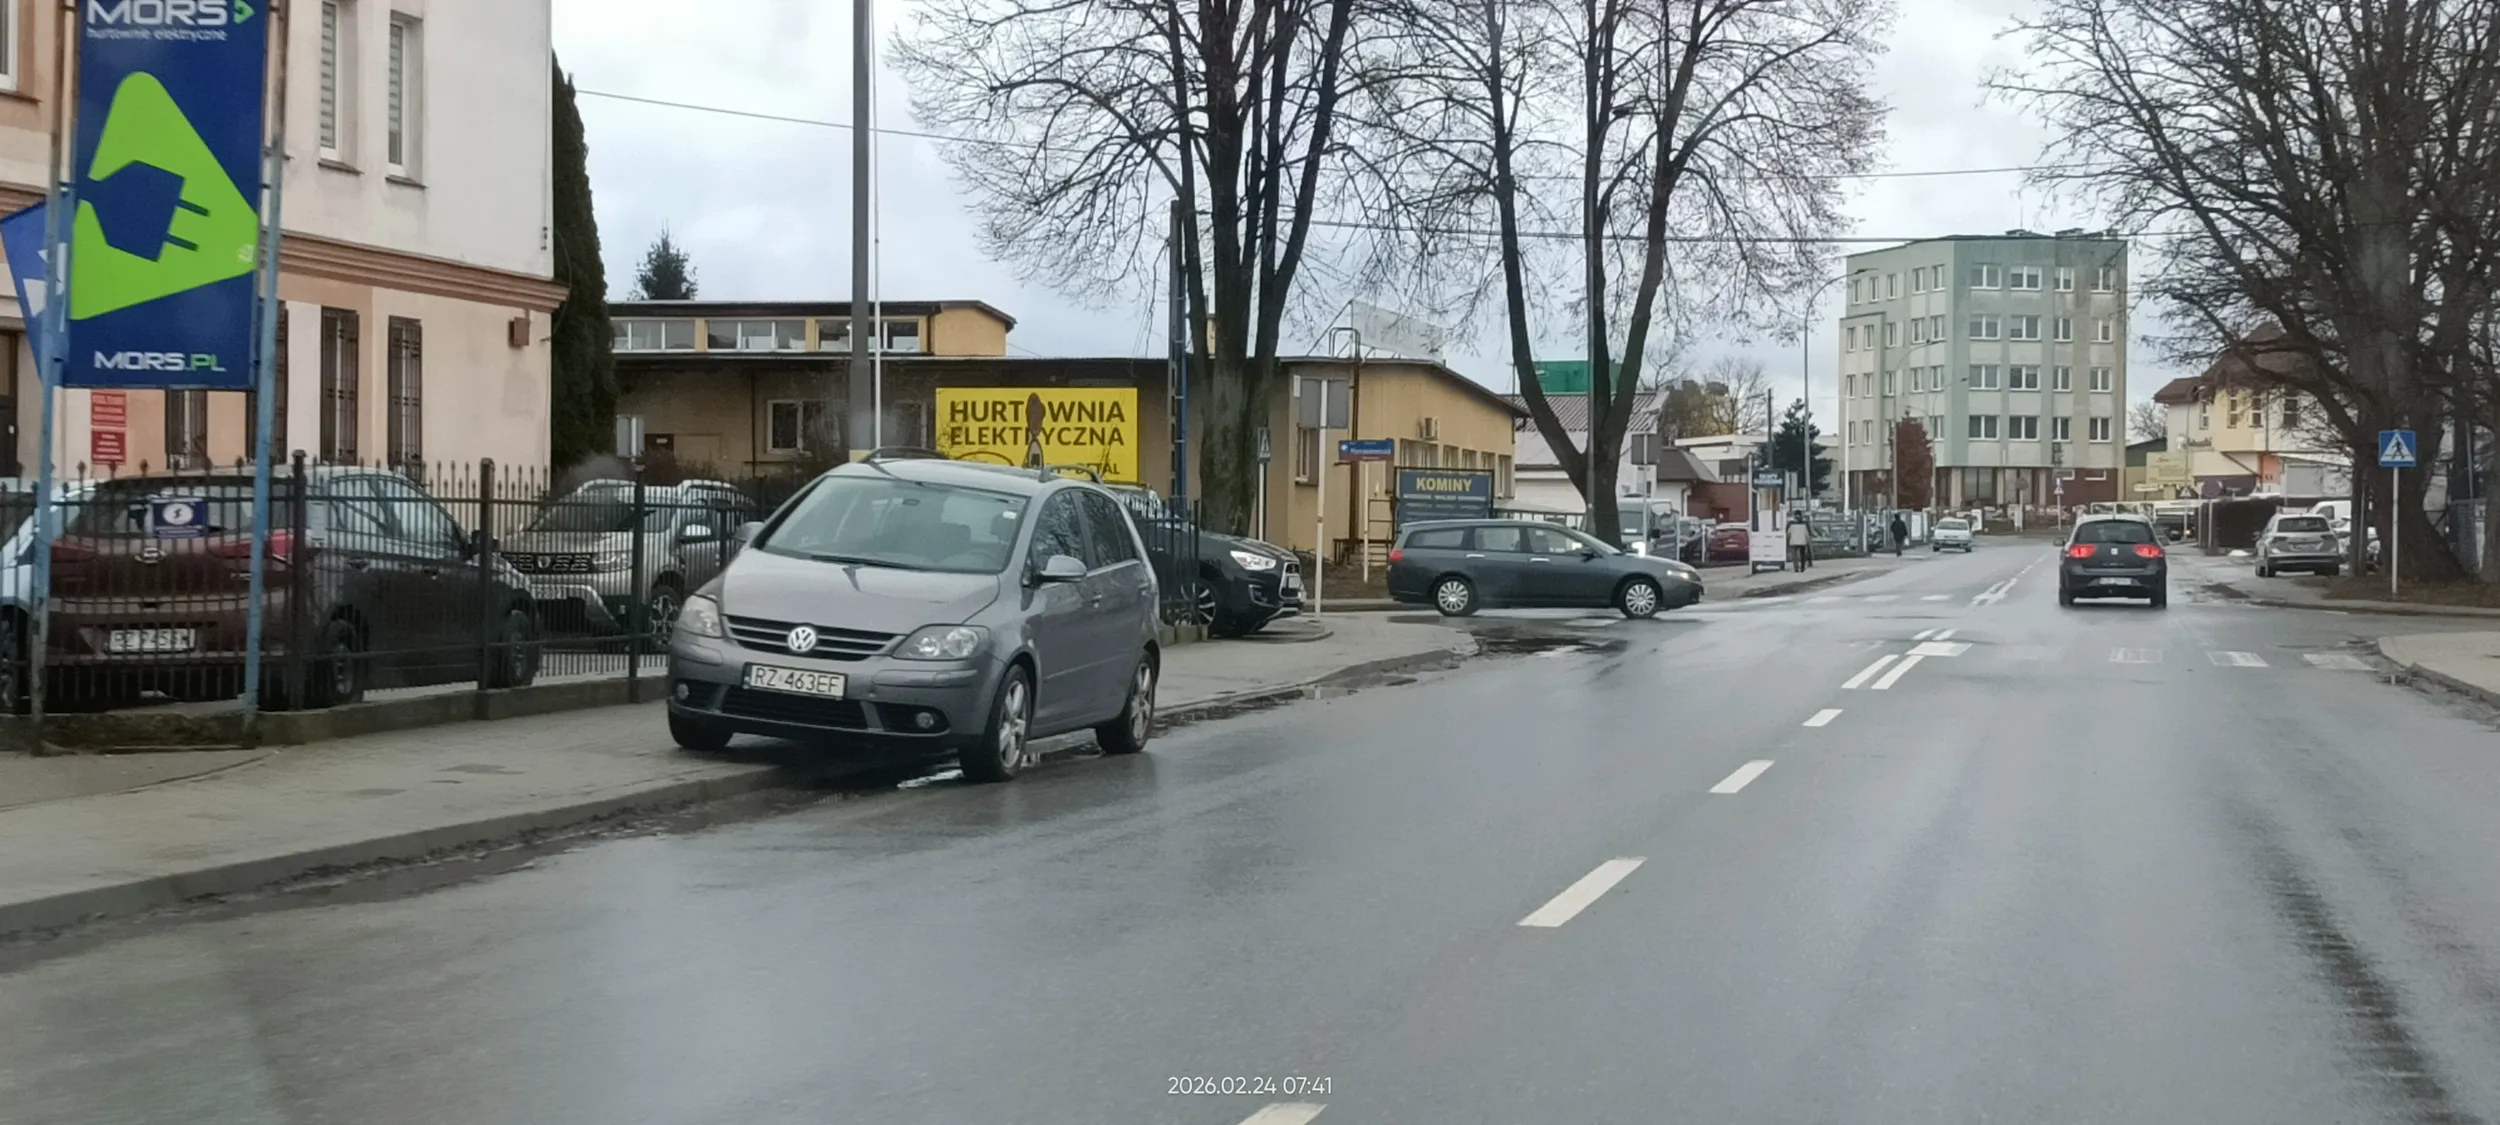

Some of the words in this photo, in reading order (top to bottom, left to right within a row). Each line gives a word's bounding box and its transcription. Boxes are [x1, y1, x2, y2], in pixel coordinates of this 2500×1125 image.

[86, 0, 228, 25] MORS
[94, 350, 228, 372] MORS.PL
[950, 401, 1125, 422] HURTWNIA
[1416, 477, 1472, 492] KOMINY
[754, 667, 778, 687] RZ
[784, 672, 840, 693] 463EF
